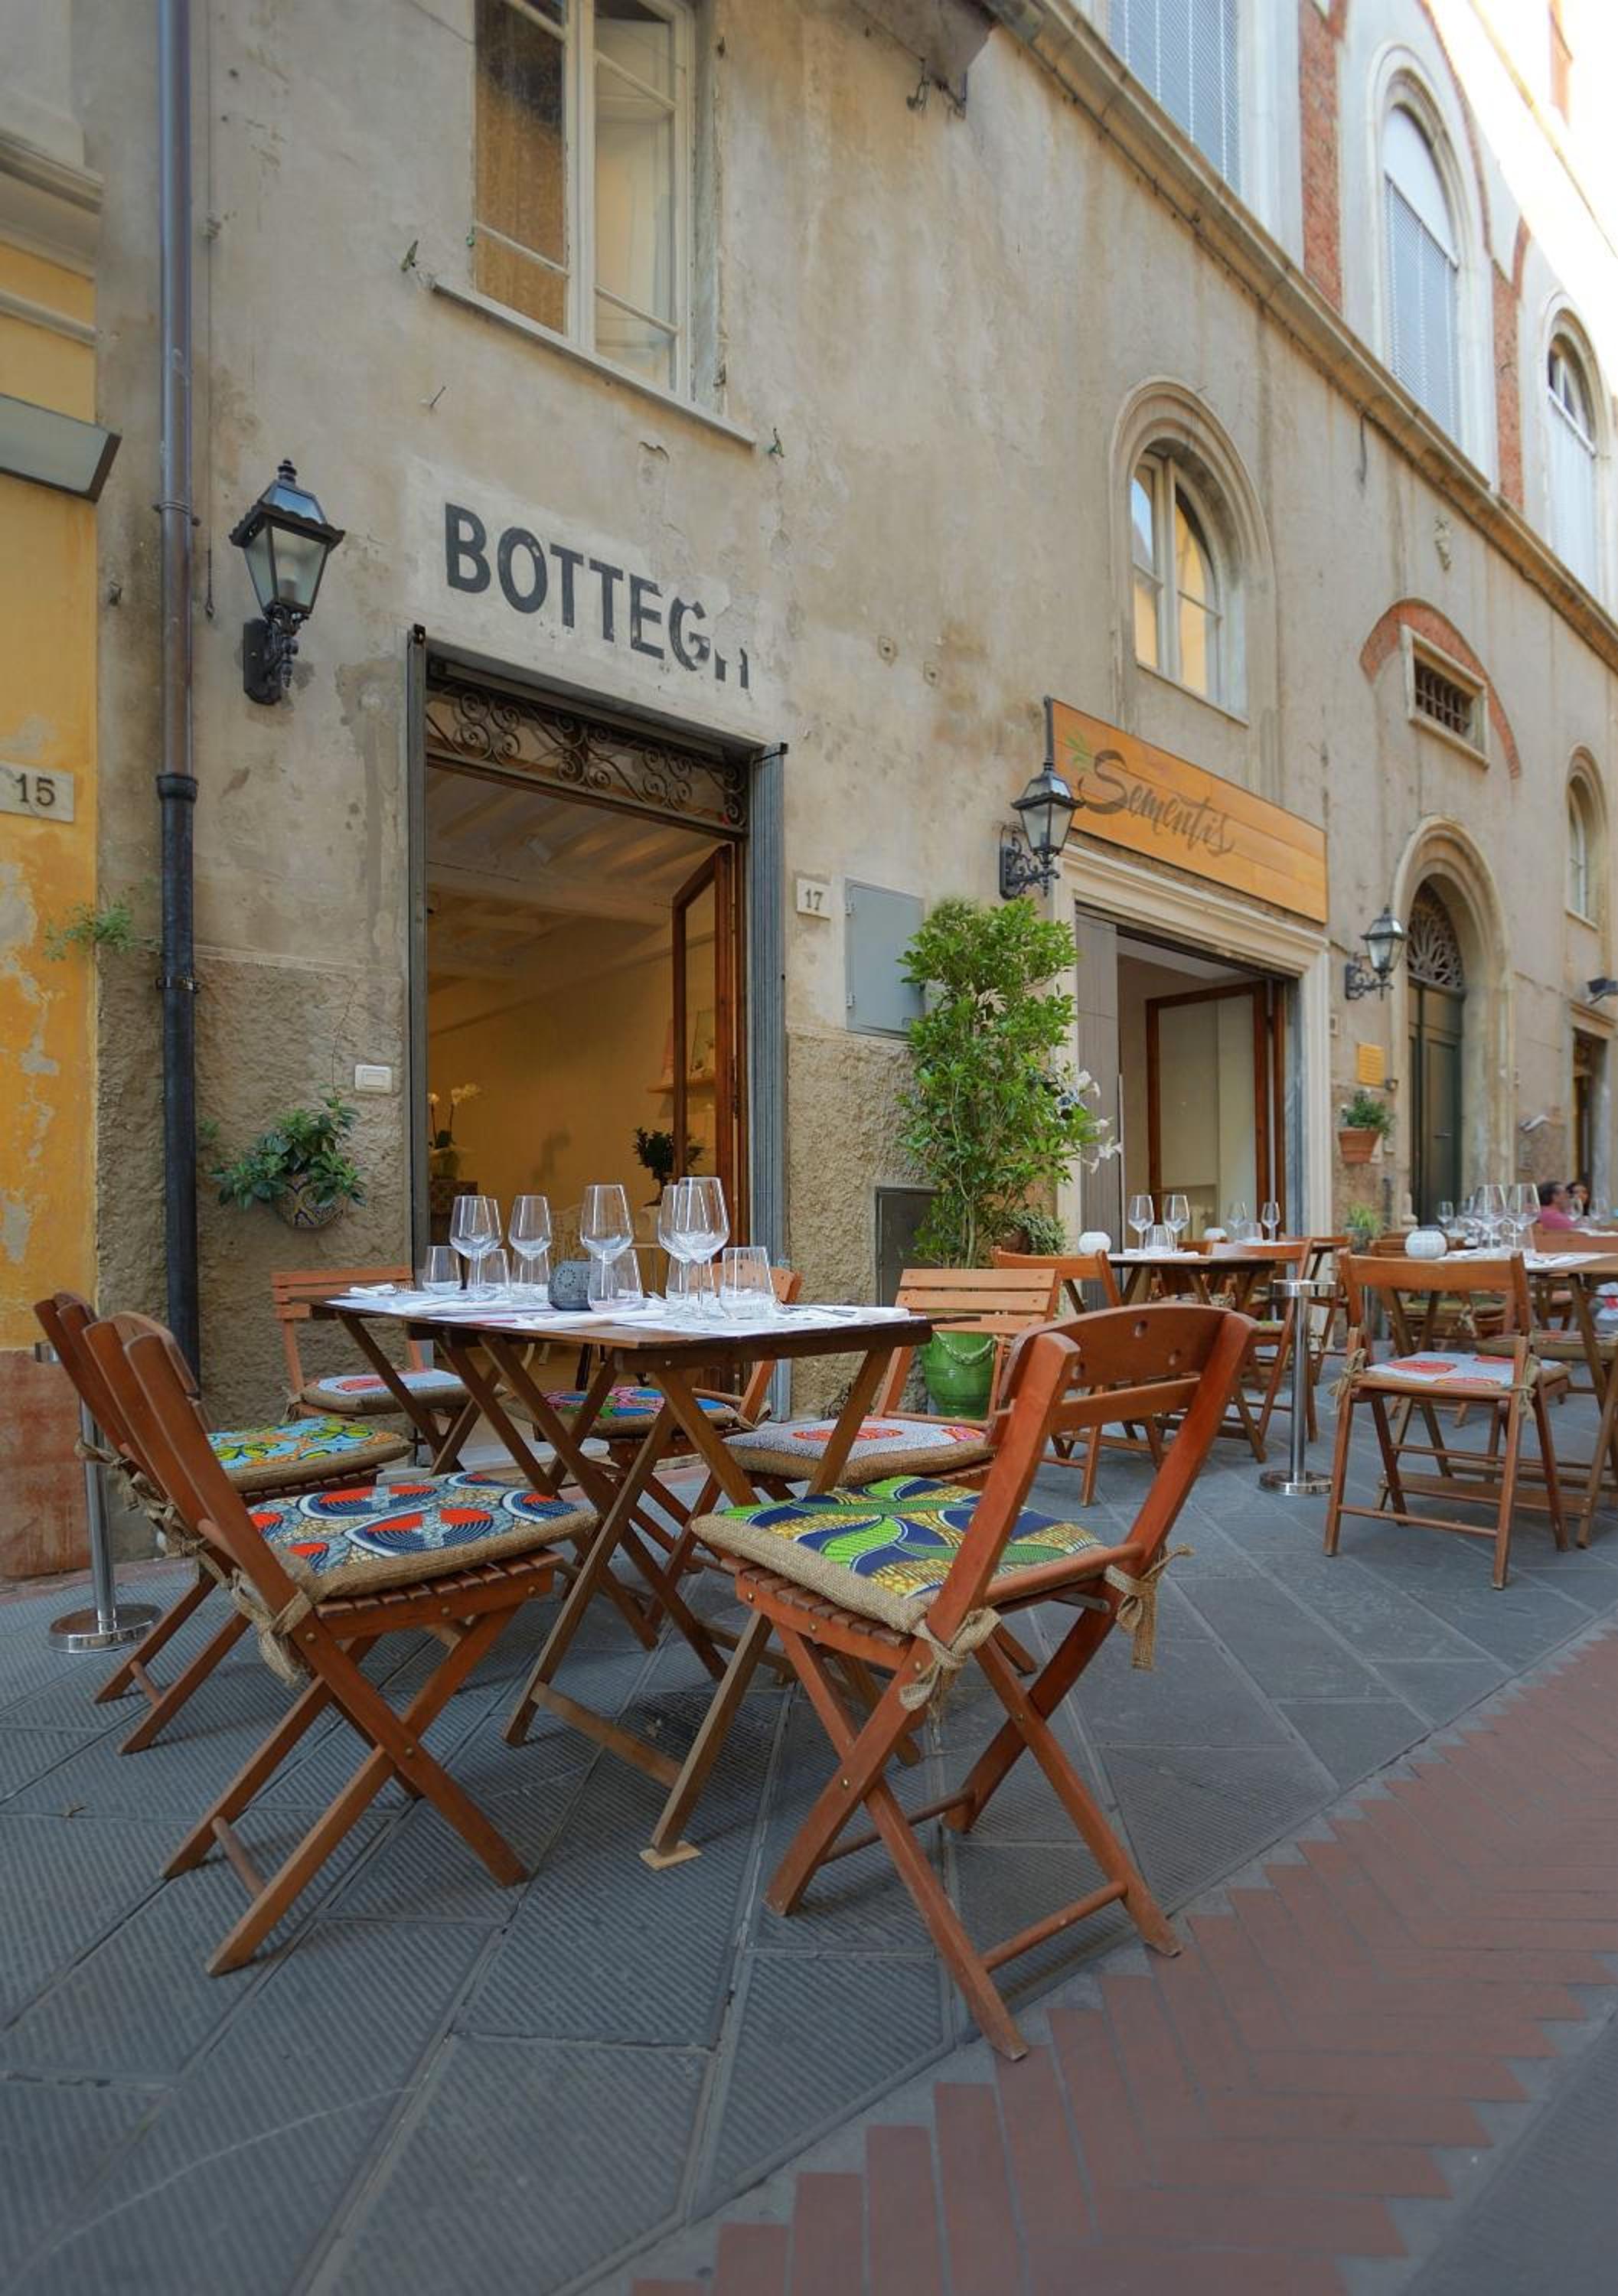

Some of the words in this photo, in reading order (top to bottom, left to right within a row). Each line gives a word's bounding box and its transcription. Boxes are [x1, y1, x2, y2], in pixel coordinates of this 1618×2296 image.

[15, 773, 56, 807] 15
[1077, 748, 1235, 856] Sementis
[805, 888, 824, 911] 17
